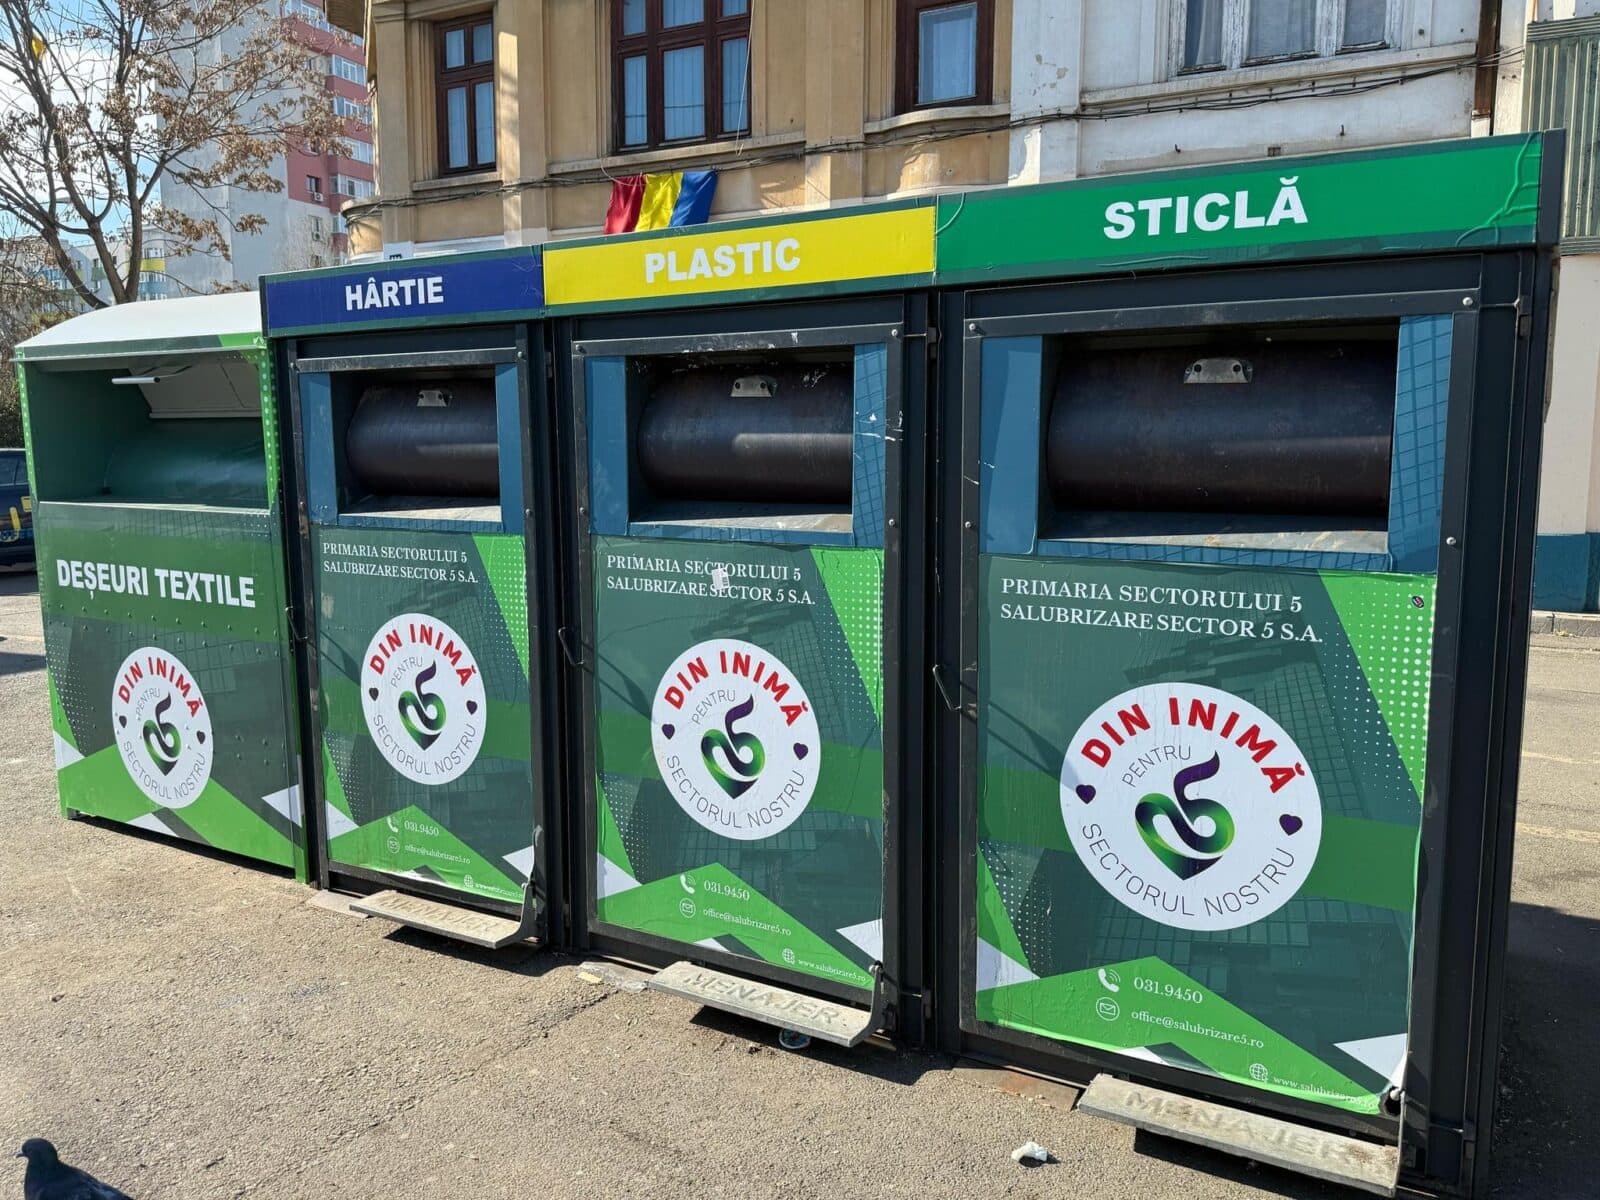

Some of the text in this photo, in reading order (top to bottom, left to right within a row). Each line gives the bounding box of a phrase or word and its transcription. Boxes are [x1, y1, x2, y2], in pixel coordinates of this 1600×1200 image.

[1103, 175, 1308, 239] STICLĂ
[645, 238, 800, 284] PLASTIC
[345, 276, 443, 311] HÂRTIE
[323, 542, 467, 564] PRIMARIA SECTORULUI 5
[323, 560, 478, 583] SALUBRIZARE SECTOR 5 S.A.
[607, 555, 681, 573] PRIMARIA
[793, 568, 801, 581] 5
[56, 559, 256, 608] DEȘEURI TEXTILE
[607, 576, 707, 597] SALUBRIZARE
[775, 588, 784, 602] 5
[788, 590, 816, 605] S.A.
[1001, 578, 1303, 613] PRIMARIA SECTORULUI 5
[1000, 603, 1323, 643] SALUBRIZARE SECTOR 5 S.A.
[369, 623, 477, 687] DIN INIMĂ
[390, 656, 424, 688] PENTRU
[118, 661, 143, 704] DIN
[136, 687, 161, 717] PENTRU
[664, 651, 809, 727] DIN INIMĂ
[691, 689, 736, 725] PENTRU
[373, 714, 476, 775] SECTORUL NOSTRU
[1081, 697, 1305, 794] DIN INIMĂ
[123, 740, 205, 800] SECTORUL NOSTRU
[1122, 744, 1192, 788] PENTRU
[667, 755, 805, 829] SECTORUL NOSTRU
[703, 879, 750, 901] 031.9450
[1082, 823, 1295, 917] SECTORUL NOSTRU
[703, 907, 791, 936] office@salubrizare5.ro
[684, 972, 839, 1024] MENAJER
[1133, 976, 1203, 1004] 031.9450
[1131, 1010, 1264, 1049] office@salubrizare5.ro
